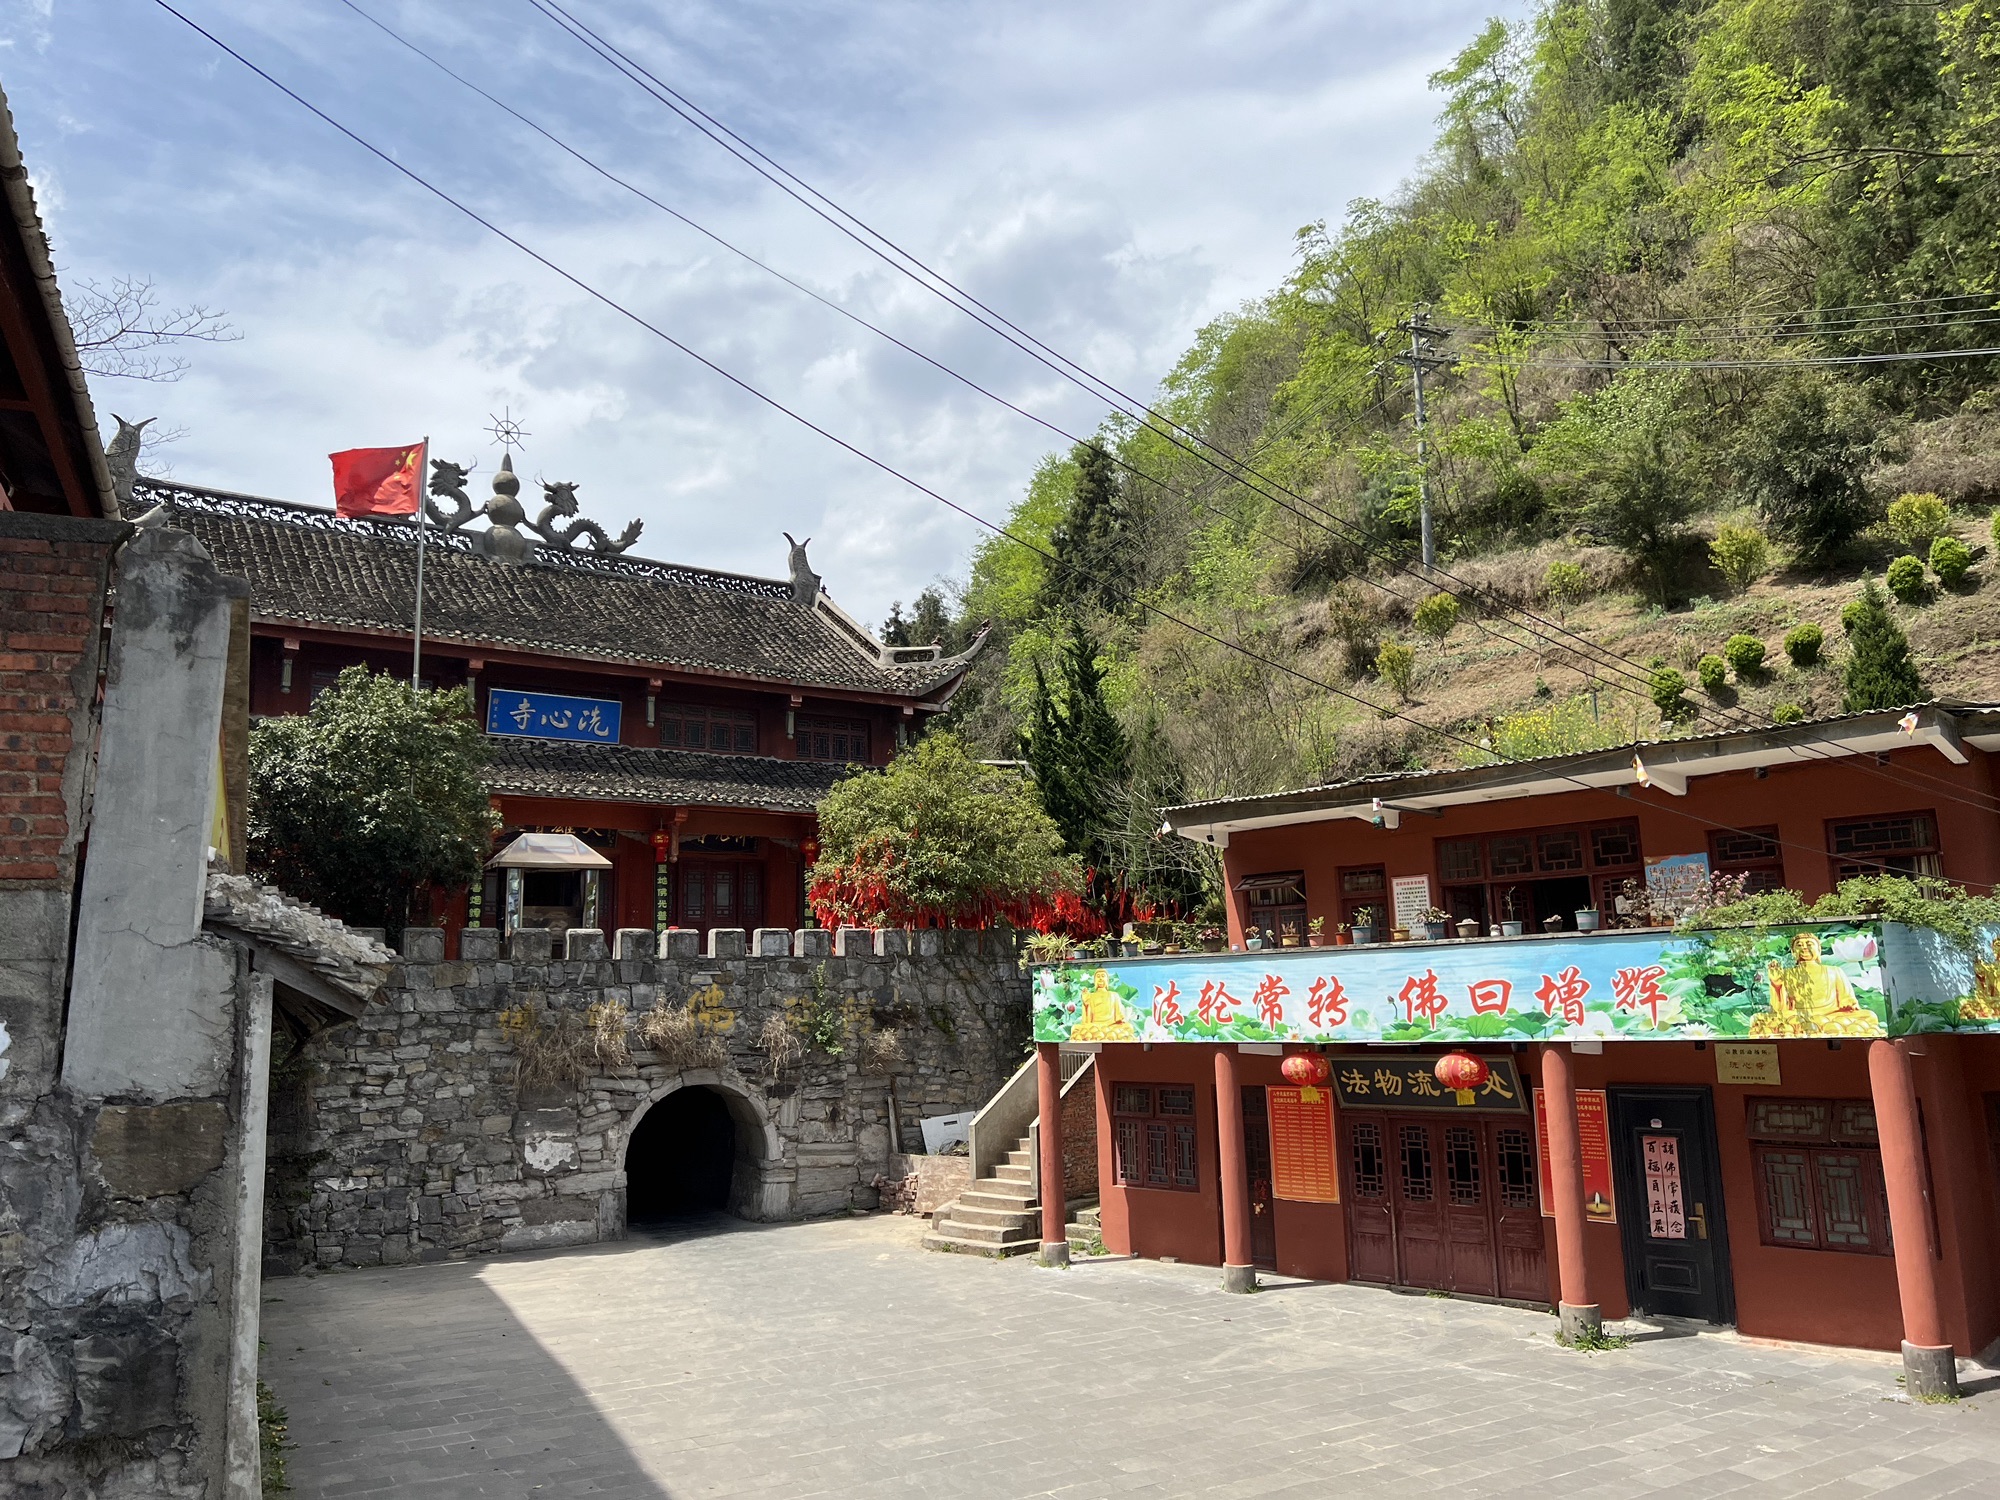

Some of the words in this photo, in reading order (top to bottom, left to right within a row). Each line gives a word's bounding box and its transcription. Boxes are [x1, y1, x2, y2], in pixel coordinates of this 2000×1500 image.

[1151, 972, 1351, 1032] 法轮常转
[1340, 1067, 1514, 1100] 法物流处
